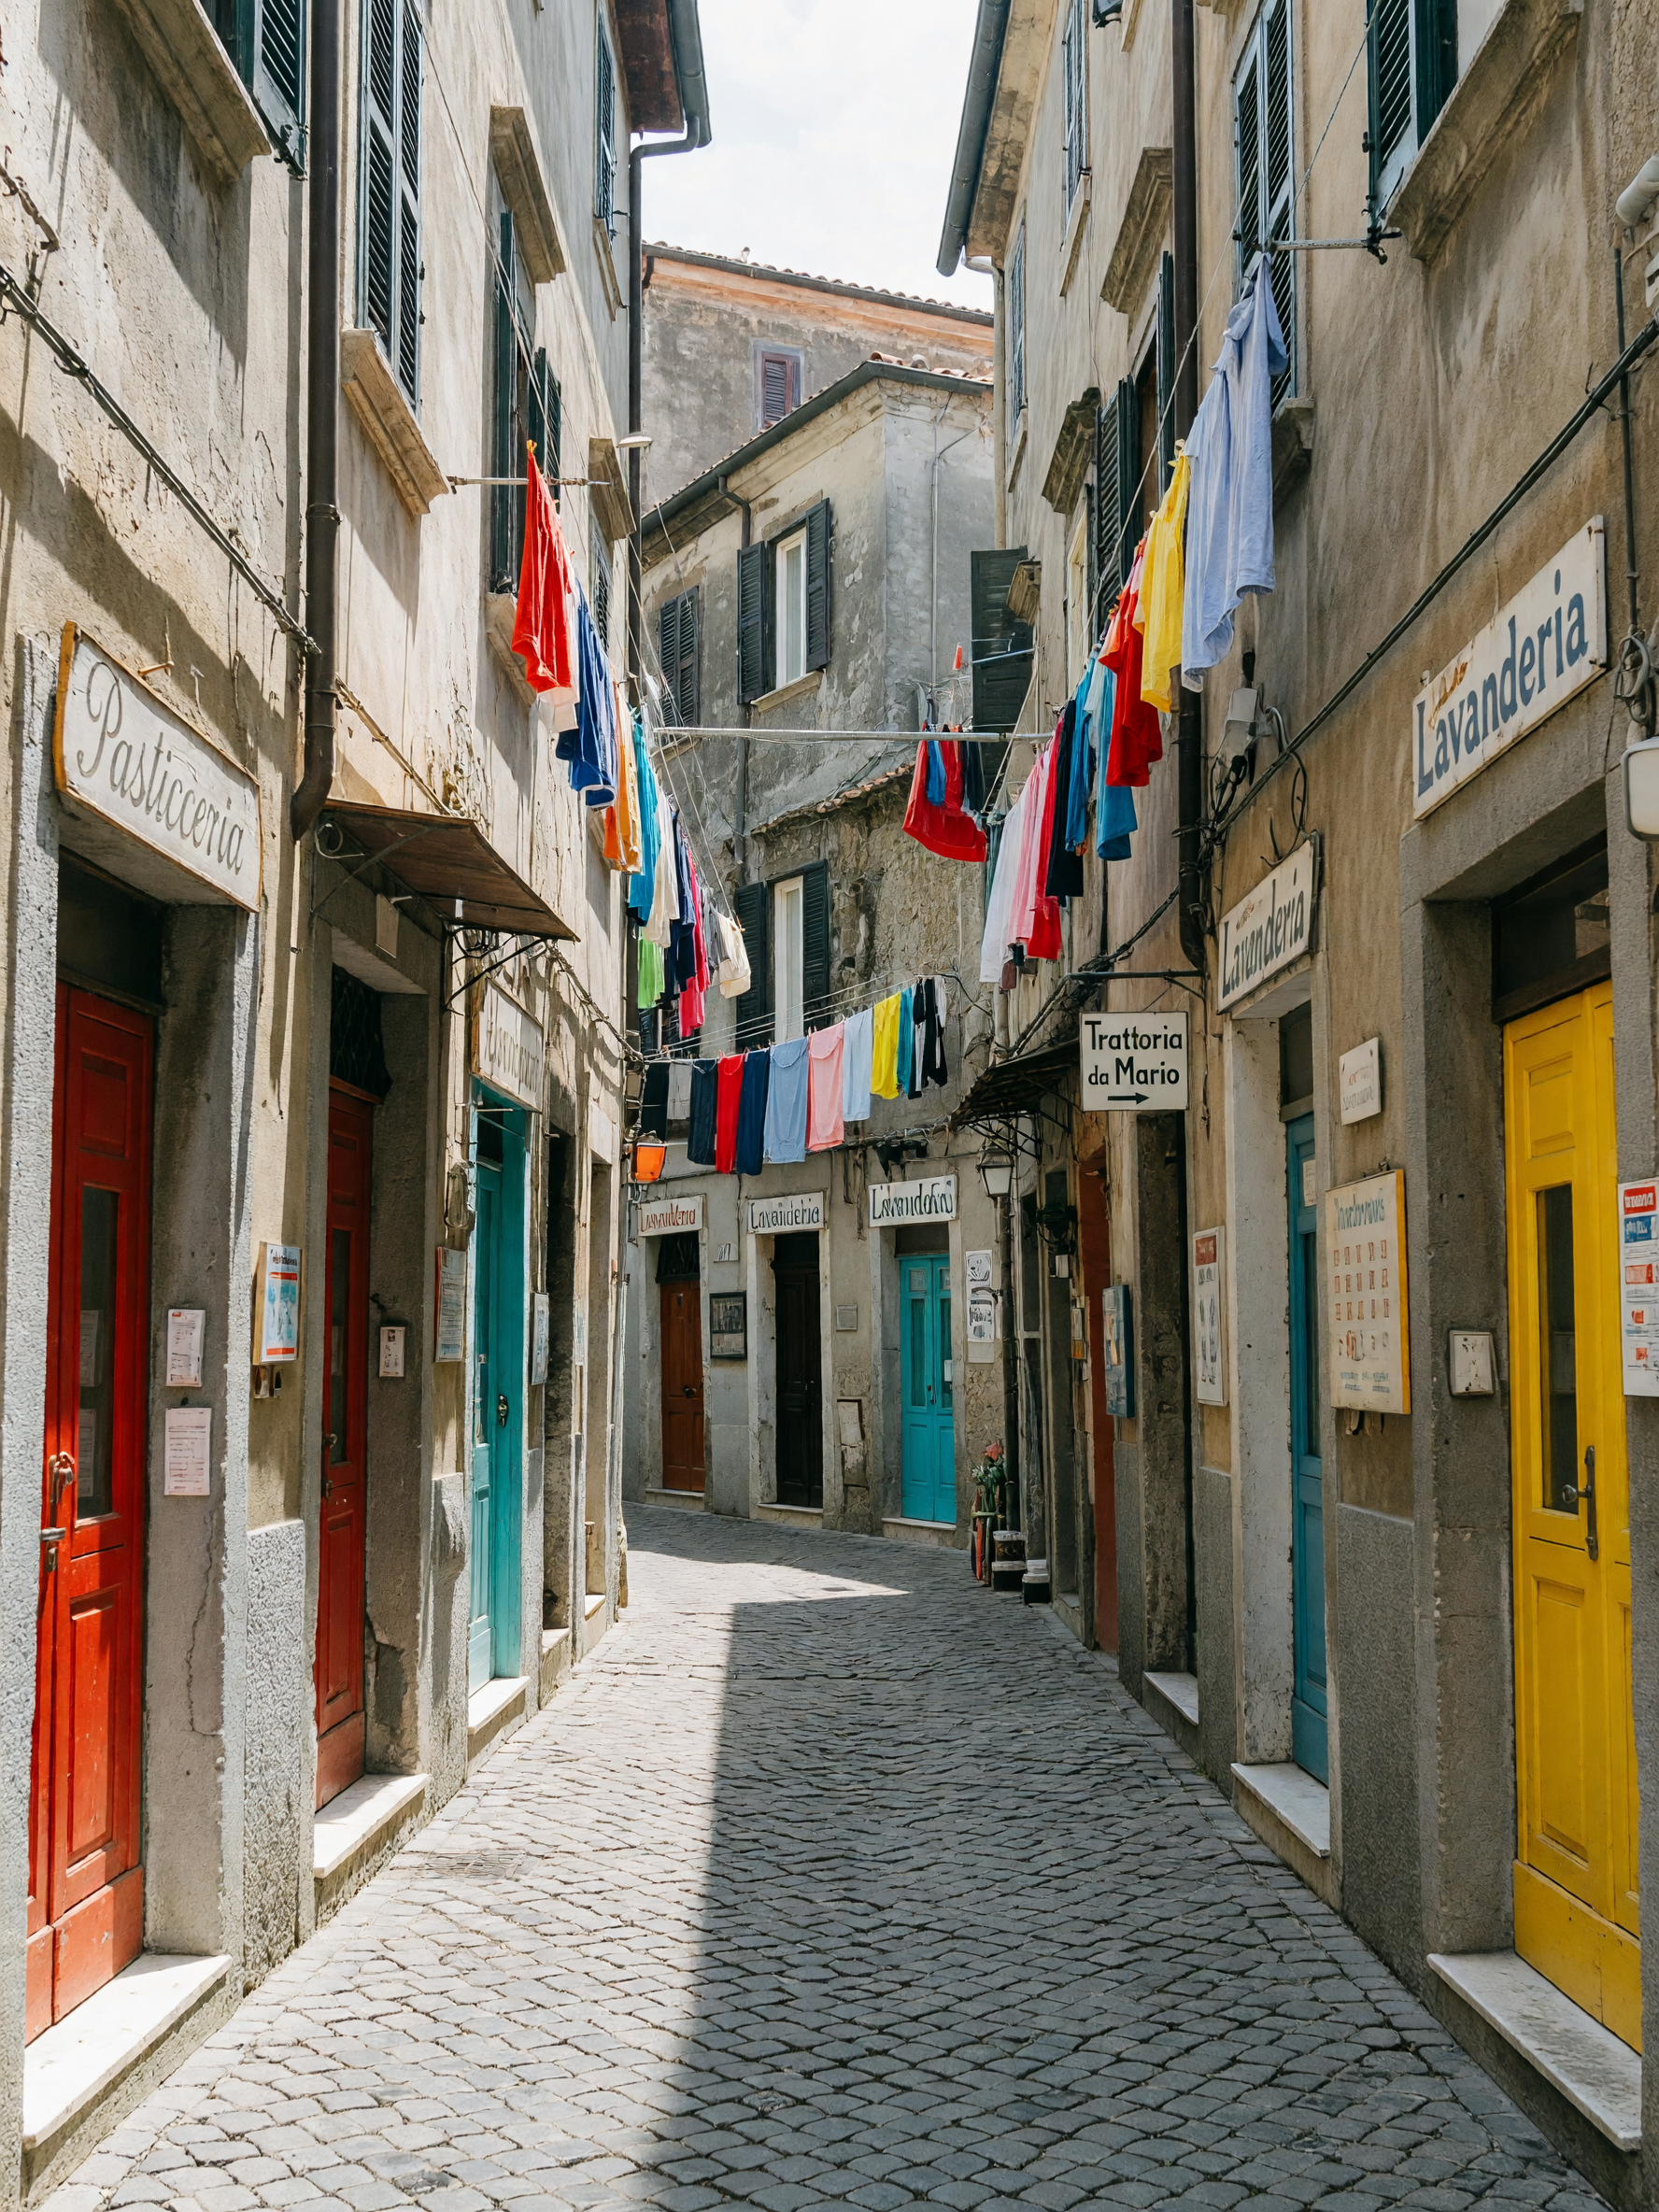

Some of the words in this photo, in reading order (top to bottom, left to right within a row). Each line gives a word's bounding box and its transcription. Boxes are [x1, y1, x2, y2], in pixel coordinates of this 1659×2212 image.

[1416, 568, 1590, 798] Lavanderia
[76, 661, 245, 875] Pasticceria
[1221, 868, 1305, 1000] Lavanderia
[1085, 1020, 1183, 1051] Trattoria
[1087, 1065, 1110, 1085] da
[1115, 1056, 1180, 1085] Mario
